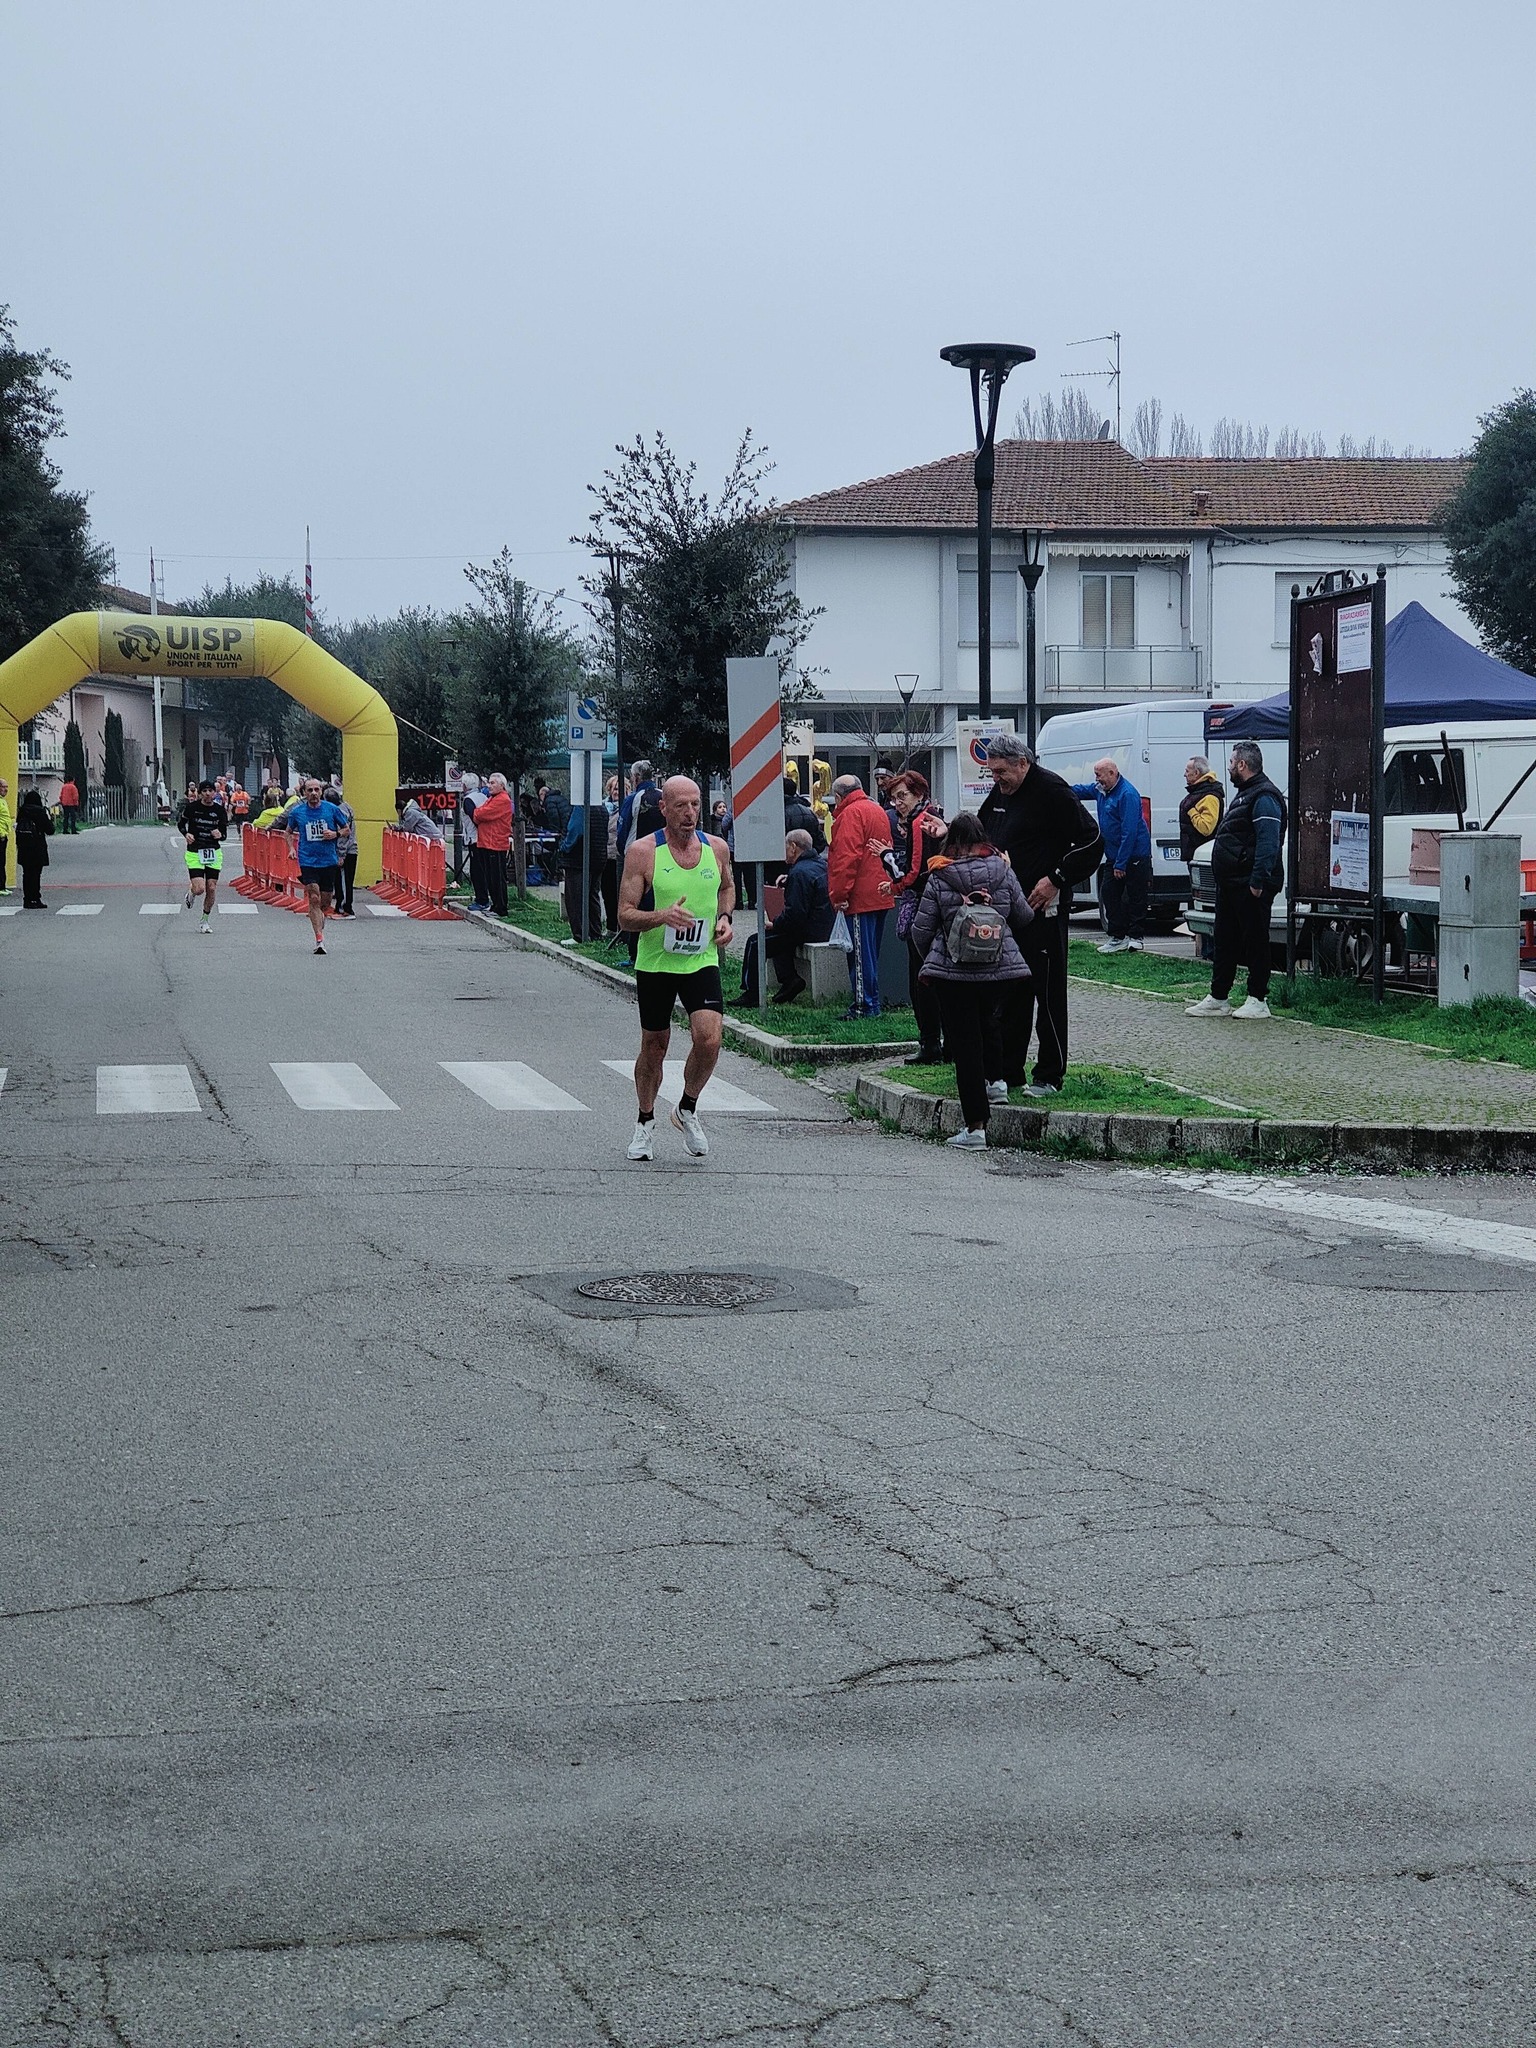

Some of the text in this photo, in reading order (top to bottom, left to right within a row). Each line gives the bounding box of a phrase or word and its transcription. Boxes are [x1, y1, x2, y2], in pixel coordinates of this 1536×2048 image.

[166, 625, 242, 652] UISP
[166, 652, 243, 662] UNIONE ITALIANA
[166, 660, 194, 668] SPORT
[573, 728, 582, 738] P
[418, 793, 457, 810] 17:05
[311, 824, 324, 836] 515
